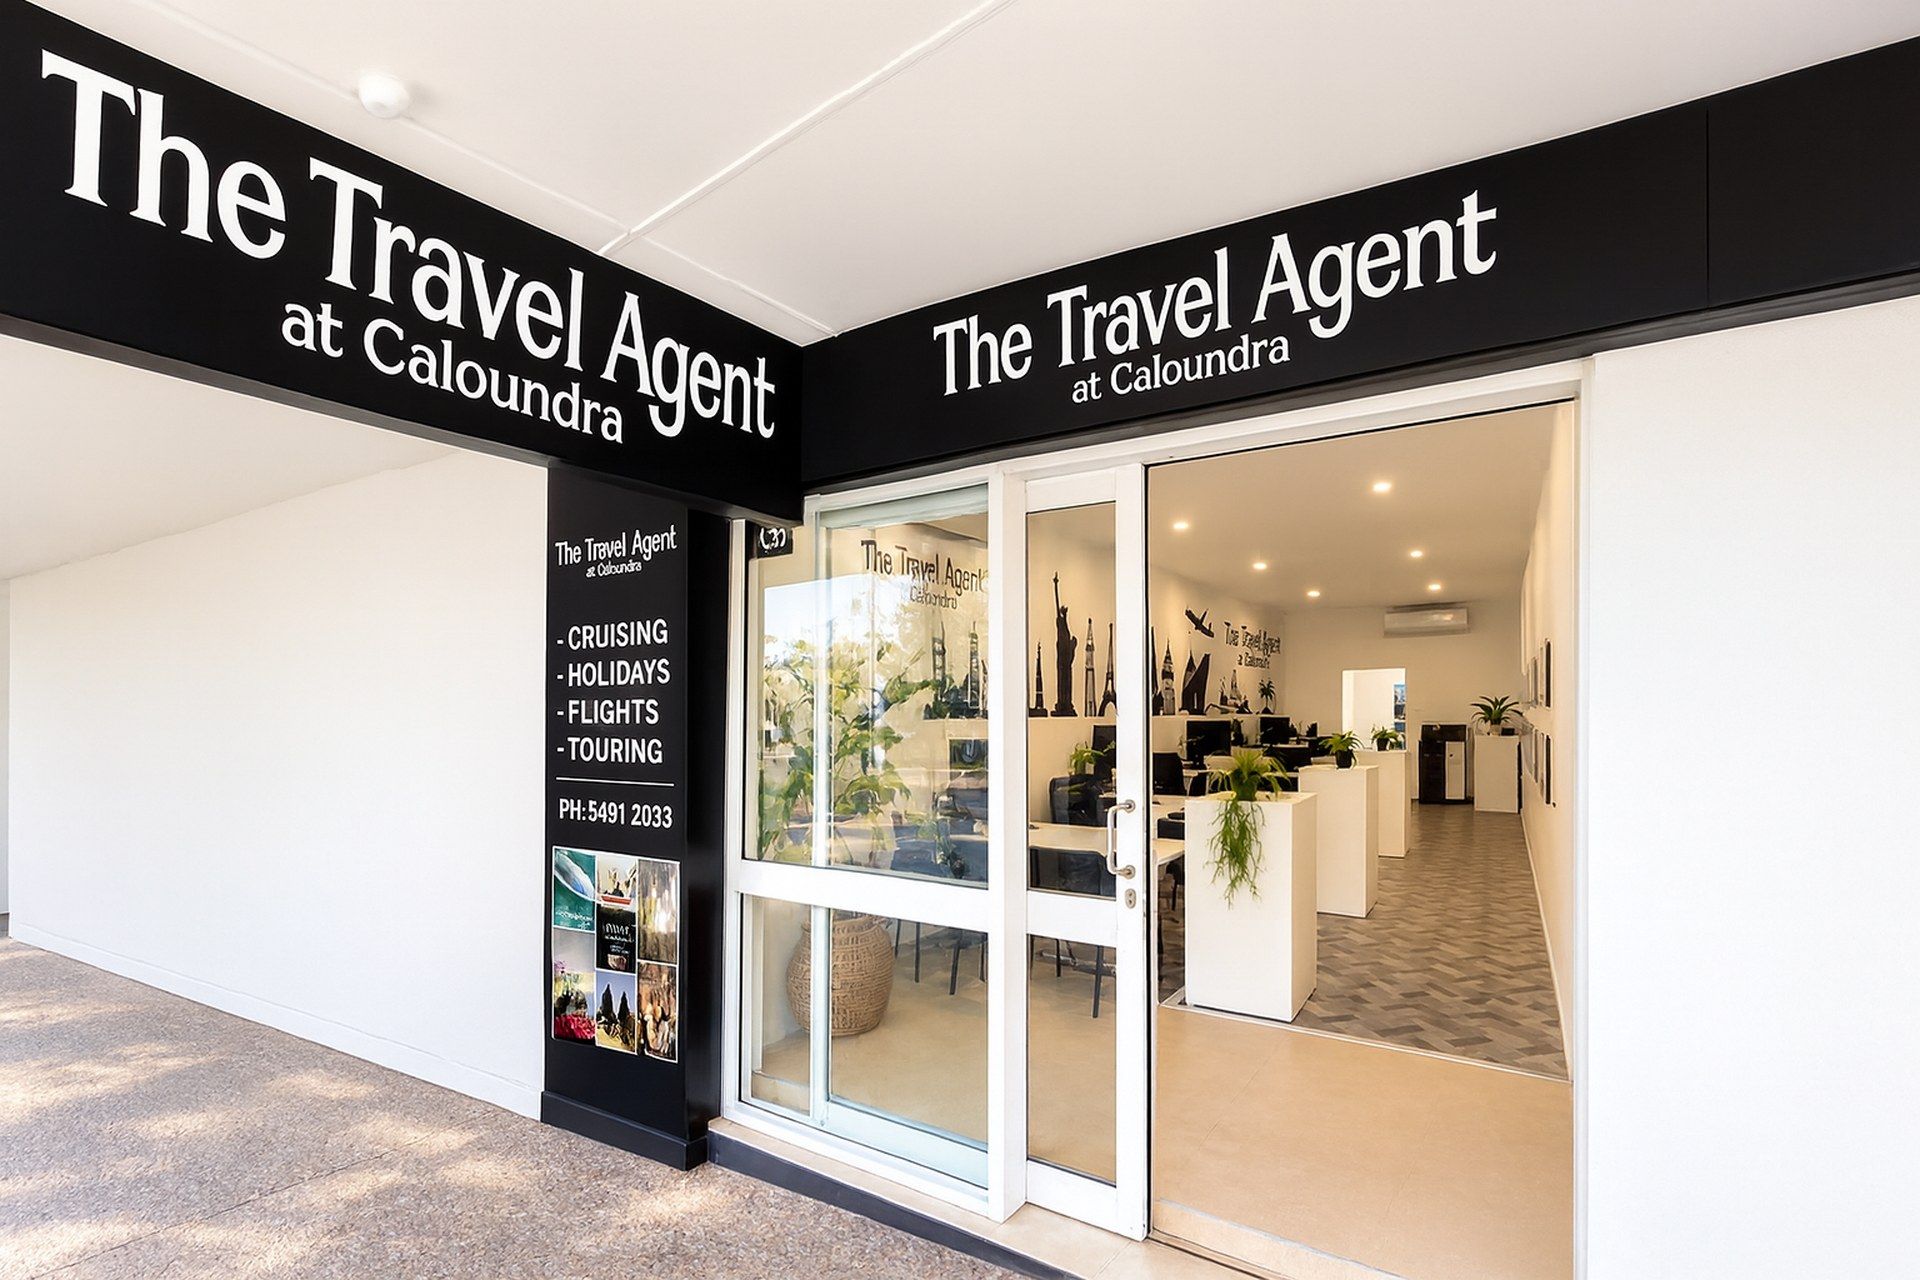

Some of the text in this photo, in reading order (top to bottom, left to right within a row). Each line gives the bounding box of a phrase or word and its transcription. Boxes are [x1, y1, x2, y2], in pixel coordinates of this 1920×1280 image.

[41, 48, 776, 439] The Travel Agent
[933, 189, 1497, 396] The Travel Agent
[281, 302, 624, 444] at Caloundra
[1071, 333, 1291, 404] at Caloundra
[554, 524, 678, 567] The Travel Agent
[860, 539, 893, 576] The
[630, 803, 673, 829] 2033
